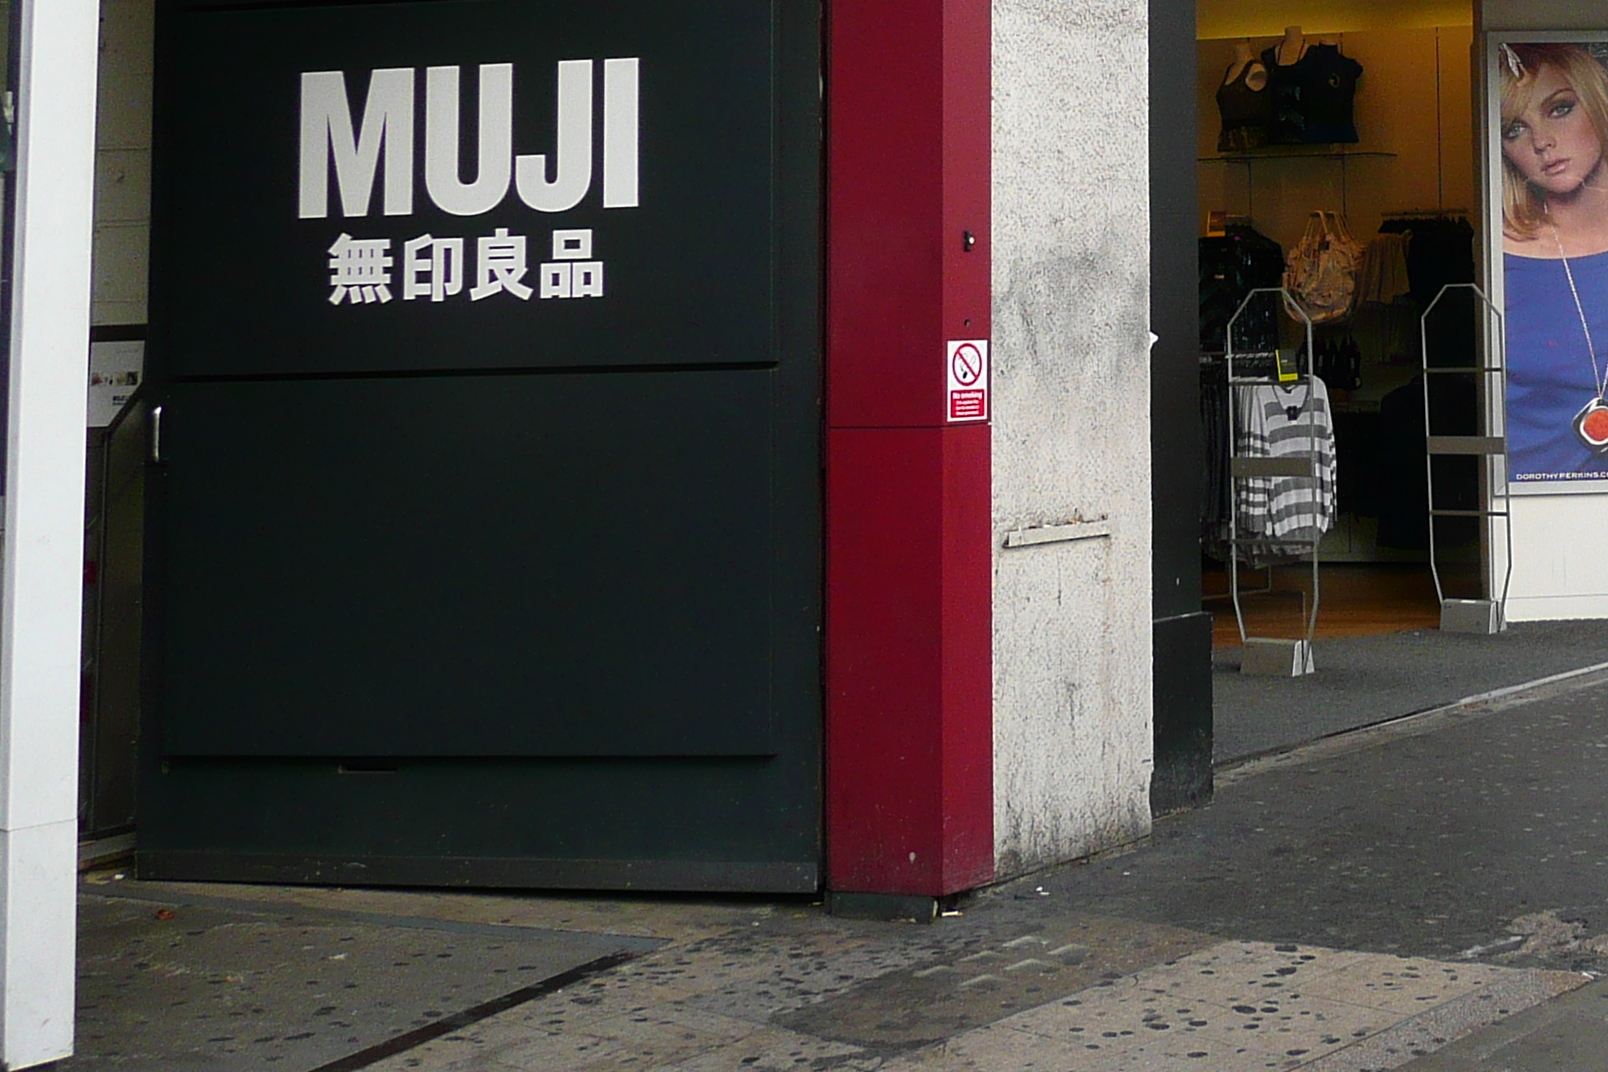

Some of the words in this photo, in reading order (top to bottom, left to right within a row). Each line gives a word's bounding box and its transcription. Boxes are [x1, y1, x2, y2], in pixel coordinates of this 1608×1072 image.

[298, 56, 640, 220] MUJI
[327, 227, 605, 306] 無印良品
